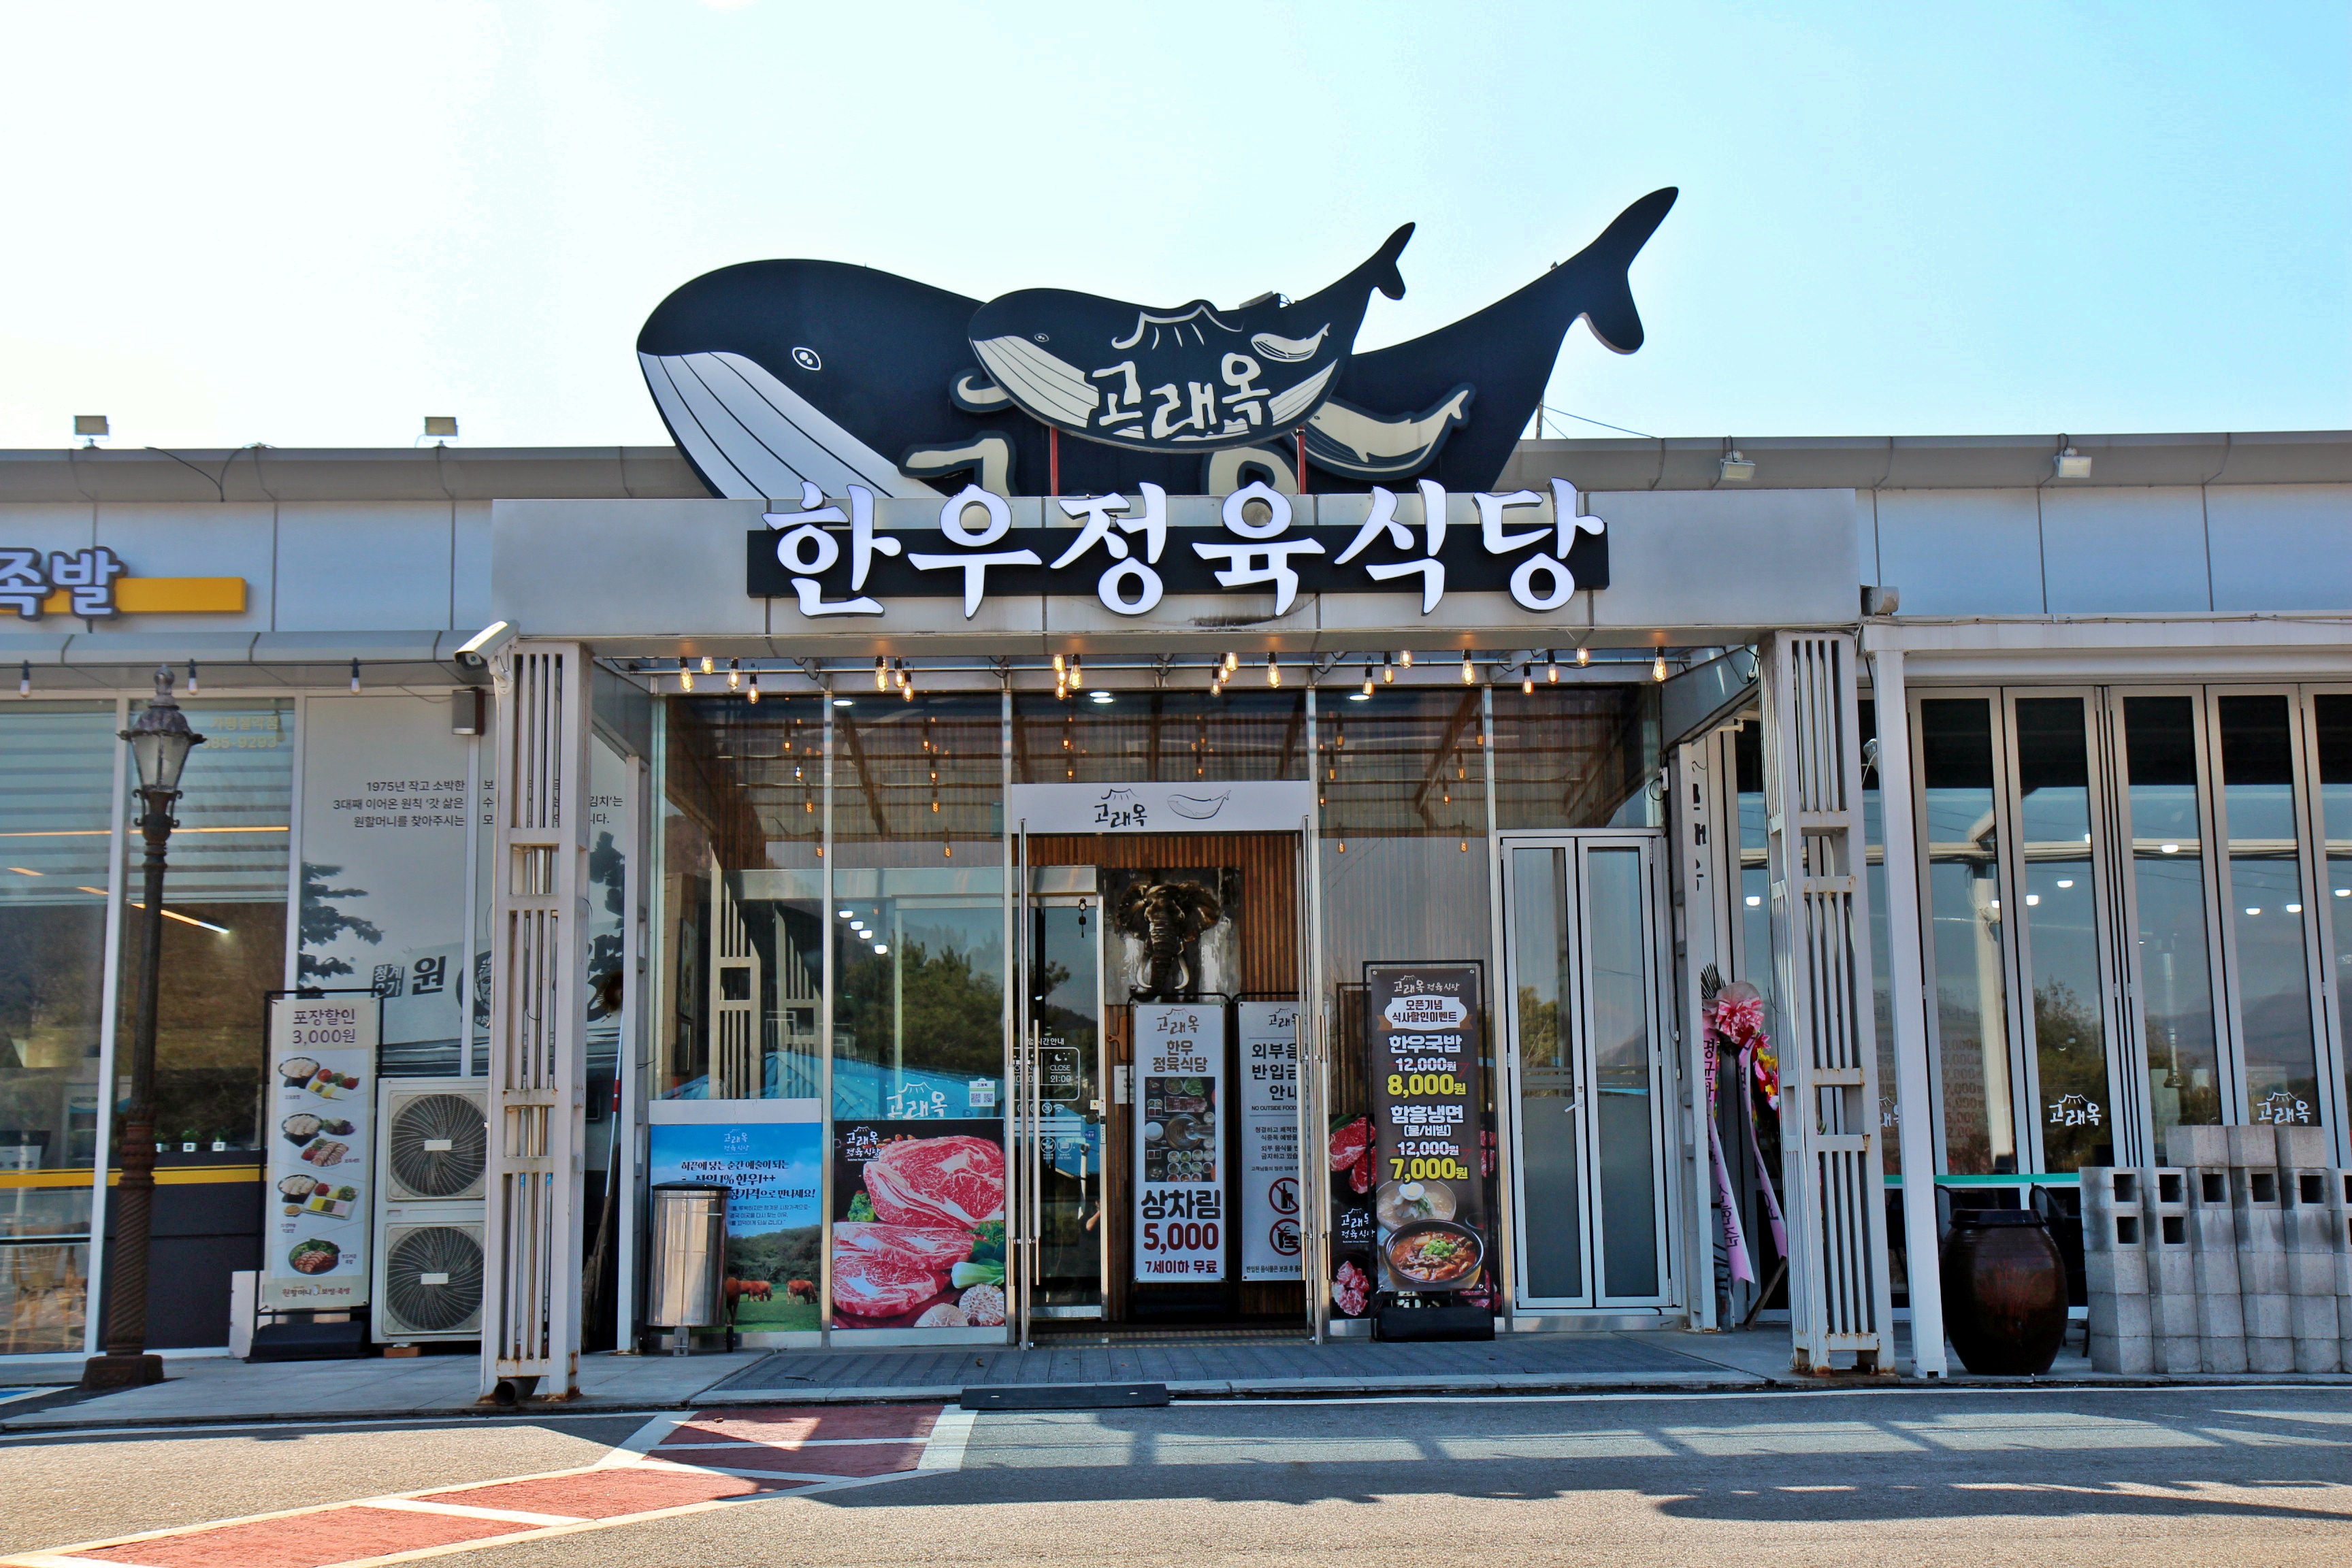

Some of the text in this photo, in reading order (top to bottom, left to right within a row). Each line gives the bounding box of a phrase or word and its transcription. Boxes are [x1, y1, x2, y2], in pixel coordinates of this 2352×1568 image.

[1092, 353, 1271, 440] 고래옥
[366, 781, 406, 792] 1975년
[409, 780, 430, 791] 작고
[433, 780, 466, 792] 소박한
[365, 798, 398, 810] 이어온
[401, 798, 423, 810] 원칙
[354, 816, 408, 828] 원할머니를
[410, 815, 466, 828] 찾아주시는
[1094, 803, 1148, 828] 고래옥
[411, 956, 446, 996] 원
[1394, 979, 1425, 994] 고래옥
[1405, 999, 1443, 1011] 오픈기념
[293, 1008, 356, 1026] 포장할인
[1156, 1015, 1200, 1035] 고래옥
[1392, 1011, 1458, 1023] 식사할인이벤트
[292, 1028, 356, 1046] 3,000원
[1388, 1034, 1463, 1054] 한우국밥
[1166, 1040, 1194, 1056] 한우
[1153, 1057, 1208, 1073] 정육식당
[1395, 1057, 1457, 1074] 12,000원
[1050, 1075, 1071, 1083] 21:00
[1388, 1074, 1467, 1098] 8,000원
[887, 1091, 948, 1120] 고래옥
[2048, 1101, 2102, 1126] 고래옥
[2257, 1098, 2311, 1124] 고래옥
[1390, 1105, 1464, 1124] 함흥냉면
[723, 1132, 748, 1144] 고래옥
[846, 1131, 879, 1146] 고래옥
[1404, 1124, 1452, 1137] (물/비빔)
[1397, 1141, 1459, 1157] 12,000원
[682, 1161, 707, 1171] 혀끝에
[728, 1160, 743, 1170] 순간
[745, 1160, 771, 1170] 예술이
[772, 1160, 789, 1169] 되는
[1390, 1158, 1469, 1183] 7,000원
[778, 1188, 816, 1199] 만나세요!
[1141, 1189, 1221, 1220] 상차림
[1143, 1222, 1219, 1255] 5,000
[1145, 1260, 1218, 1274] 7세이하 무료
